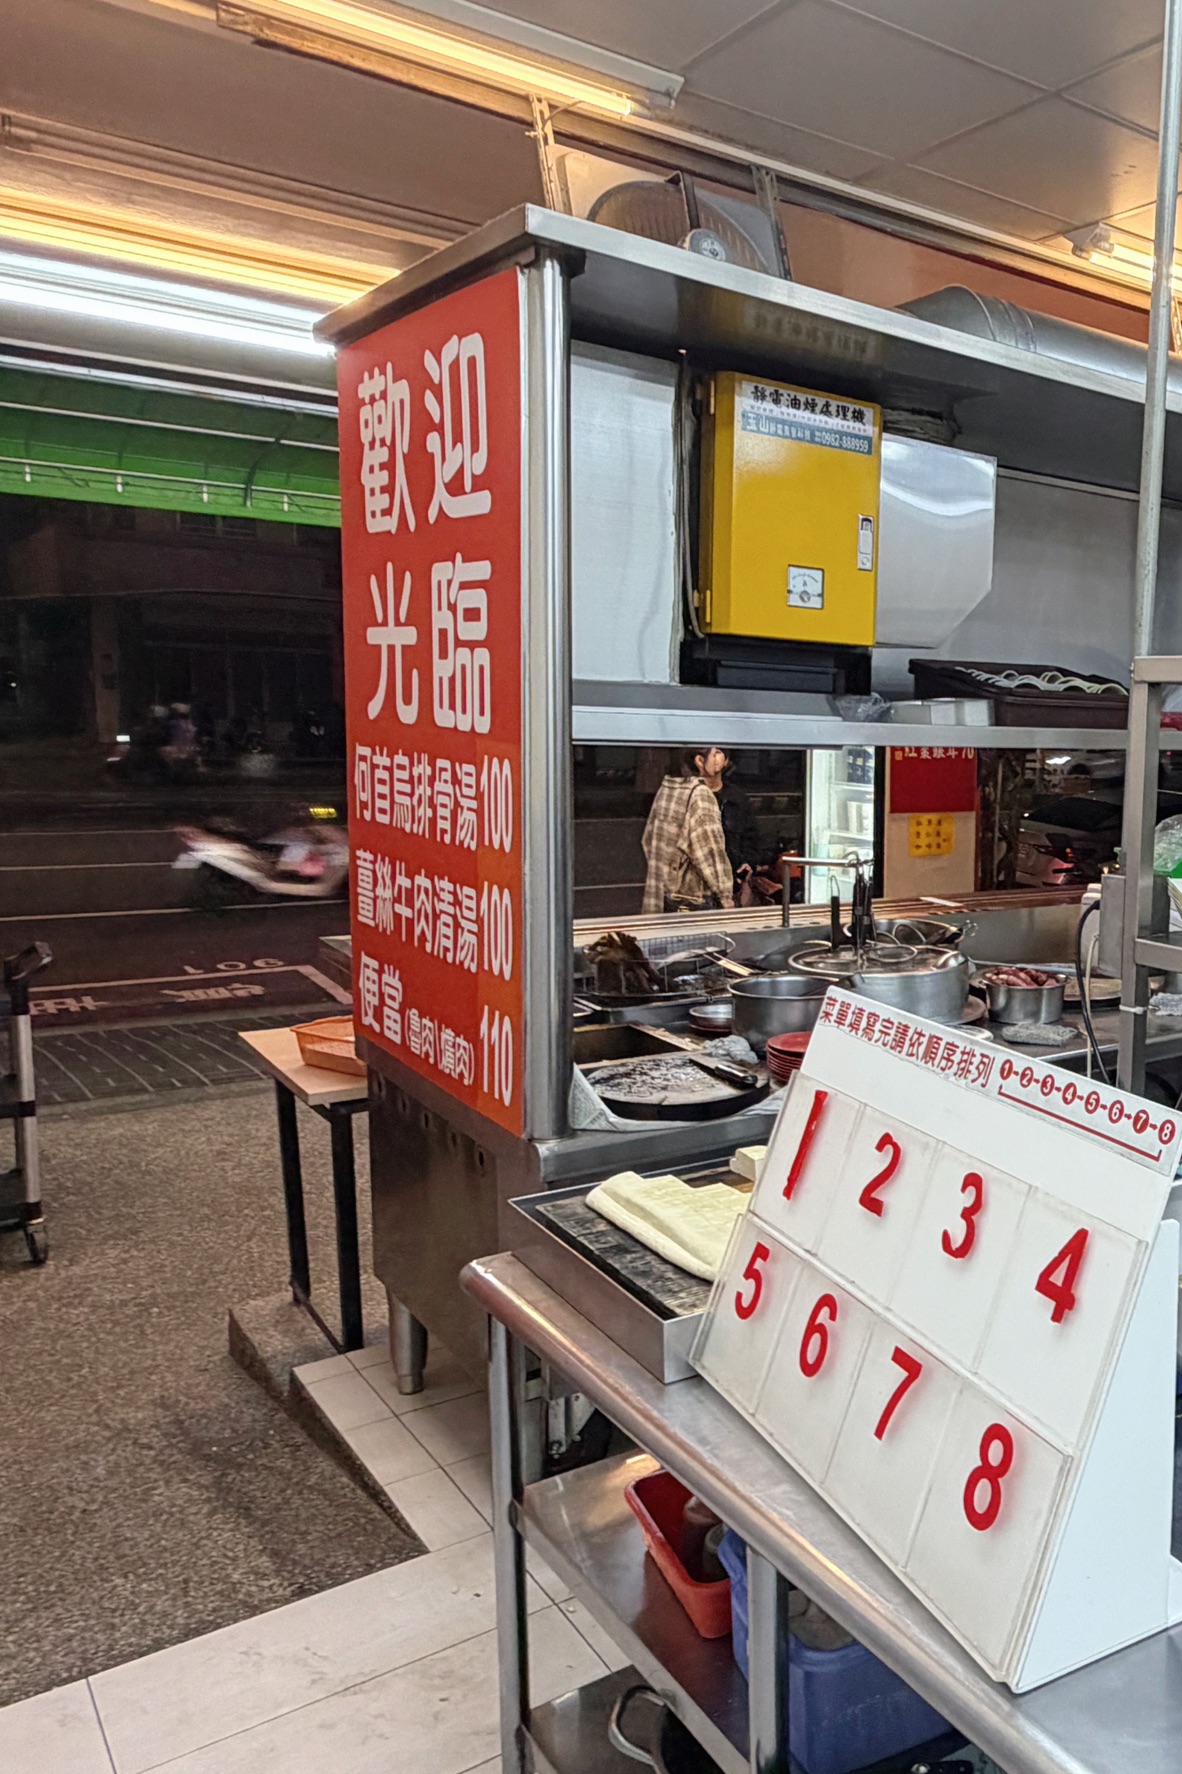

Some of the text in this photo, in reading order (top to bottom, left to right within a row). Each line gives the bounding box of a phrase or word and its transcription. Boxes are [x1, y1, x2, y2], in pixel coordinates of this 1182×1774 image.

[357, 331, 492, 535] 歡迎
[751, 385, 867, 426] 靜電油煙處理機
[366, 551, 492, 734] 光臨
[354, 742, 512, 853] 何首烏排骨湯 100
[355, 848, 513, 981] 薑絲牛肉清湯 100
[358, 951, 403, 1045] 便當
[480, 1005, 513, 1107] 110
[819, 996, 996, 1088] 菜單填寫完請依順序排列
[782, 1089, 1089, 1324] 1 2 3 4
[735, 1242, 1013, 1531] 5 6 7 8
